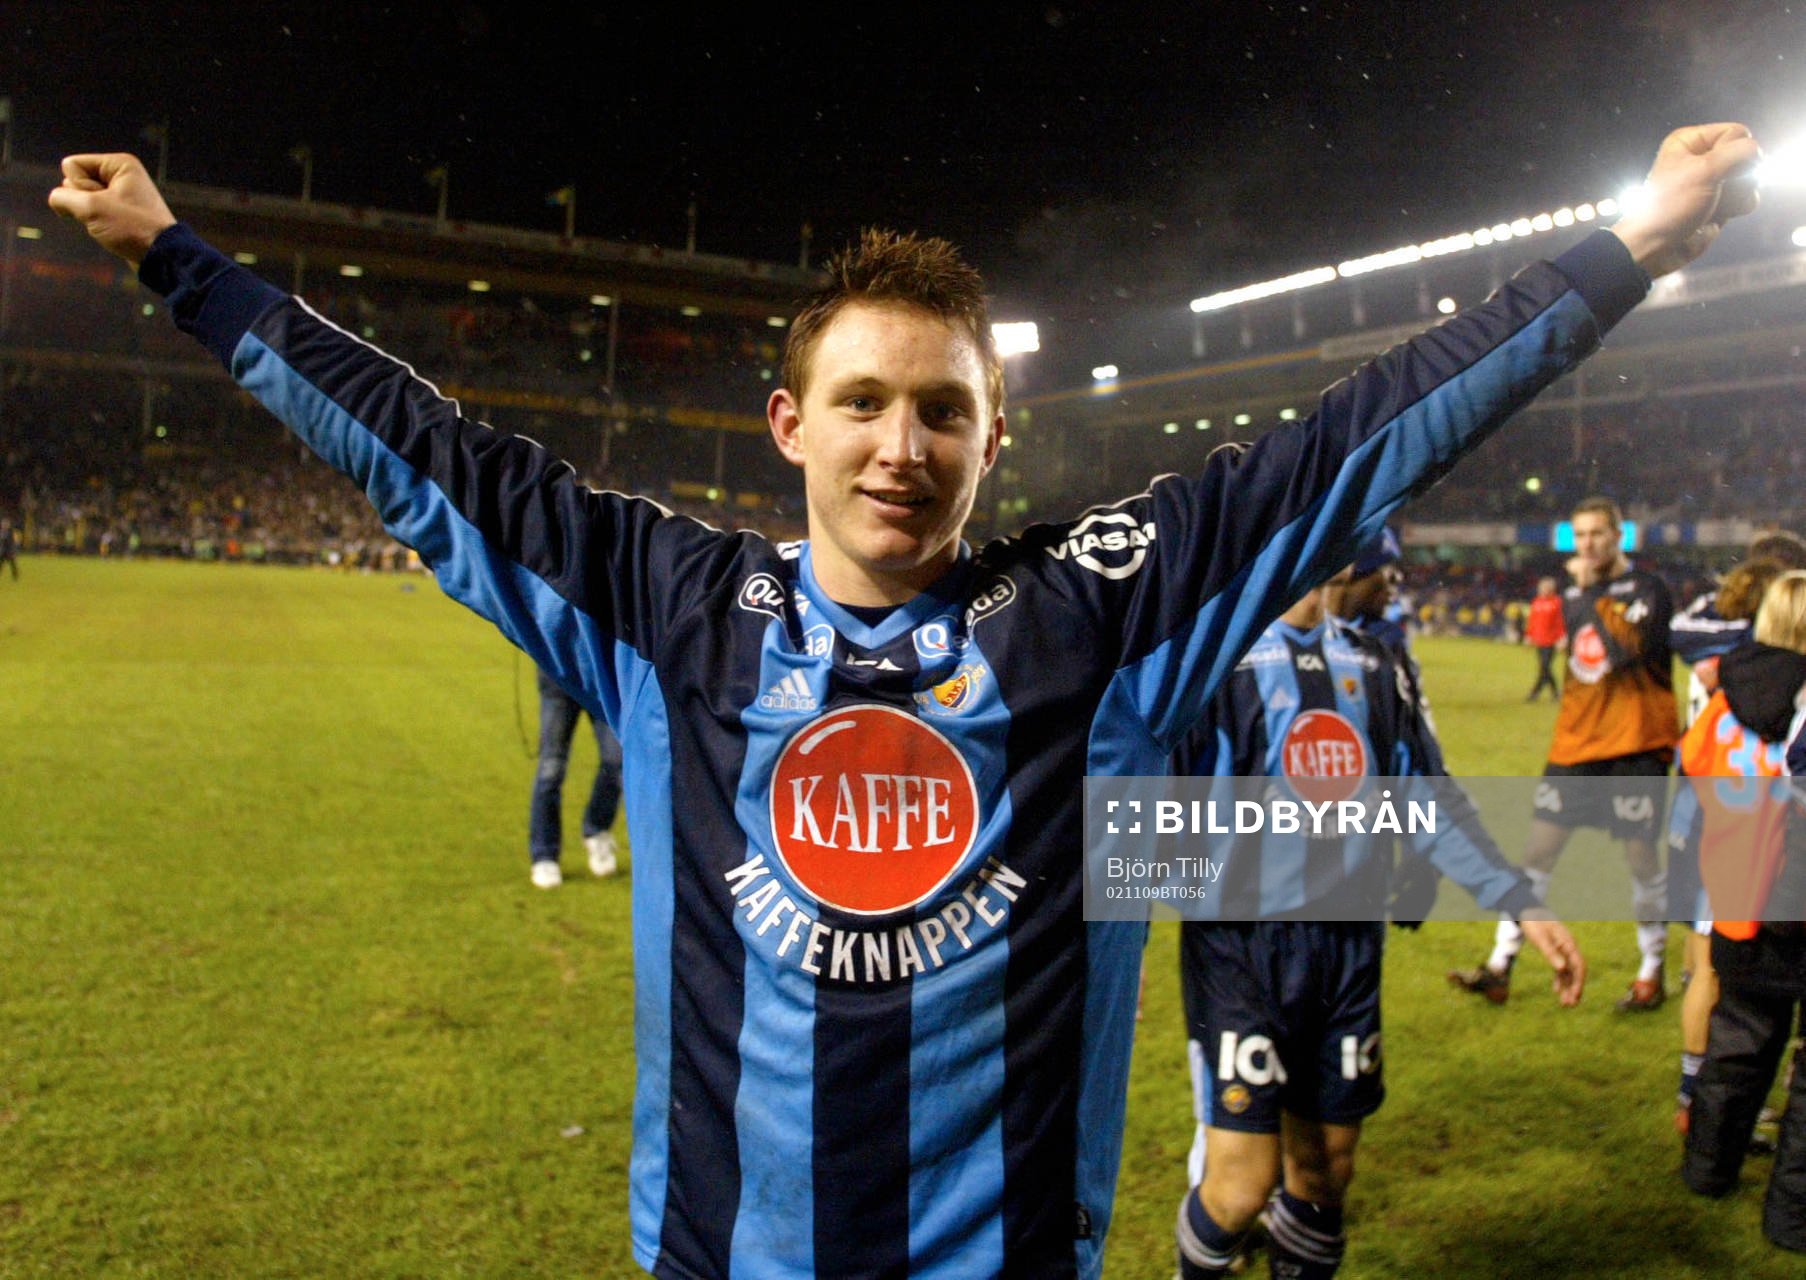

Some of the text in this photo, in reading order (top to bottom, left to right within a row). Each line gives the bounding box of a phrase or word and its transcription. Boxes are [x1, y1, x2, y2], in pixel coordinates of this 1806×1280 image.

[760, 688, 817, 711] adidas
[1289, 740, 1359, 778] KAFFE
[789, 772, 956, 853] KAFFE
[724, 853, 1028, 983] KAFFEKNAPPEN
